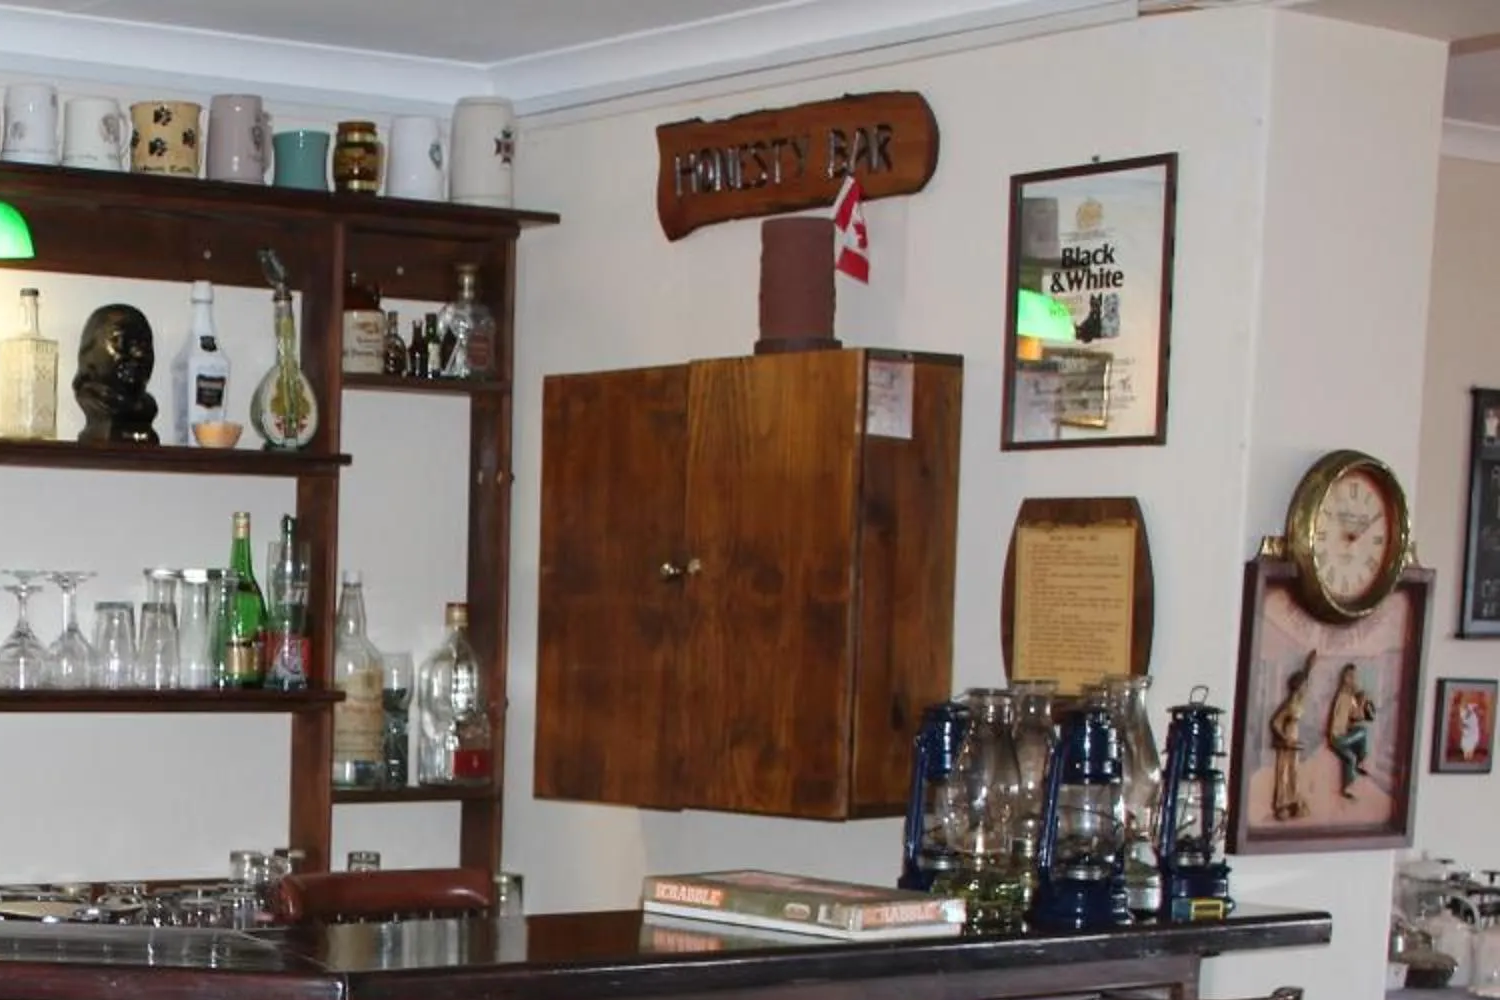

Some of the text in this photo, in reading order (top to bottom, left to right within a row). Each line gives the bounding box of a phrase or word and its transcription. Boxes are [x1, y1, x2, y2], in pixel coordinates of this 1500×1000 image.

[674, 123, 895, 197] HONESTY BAR
[1061, 242, 1116, 269] Black
